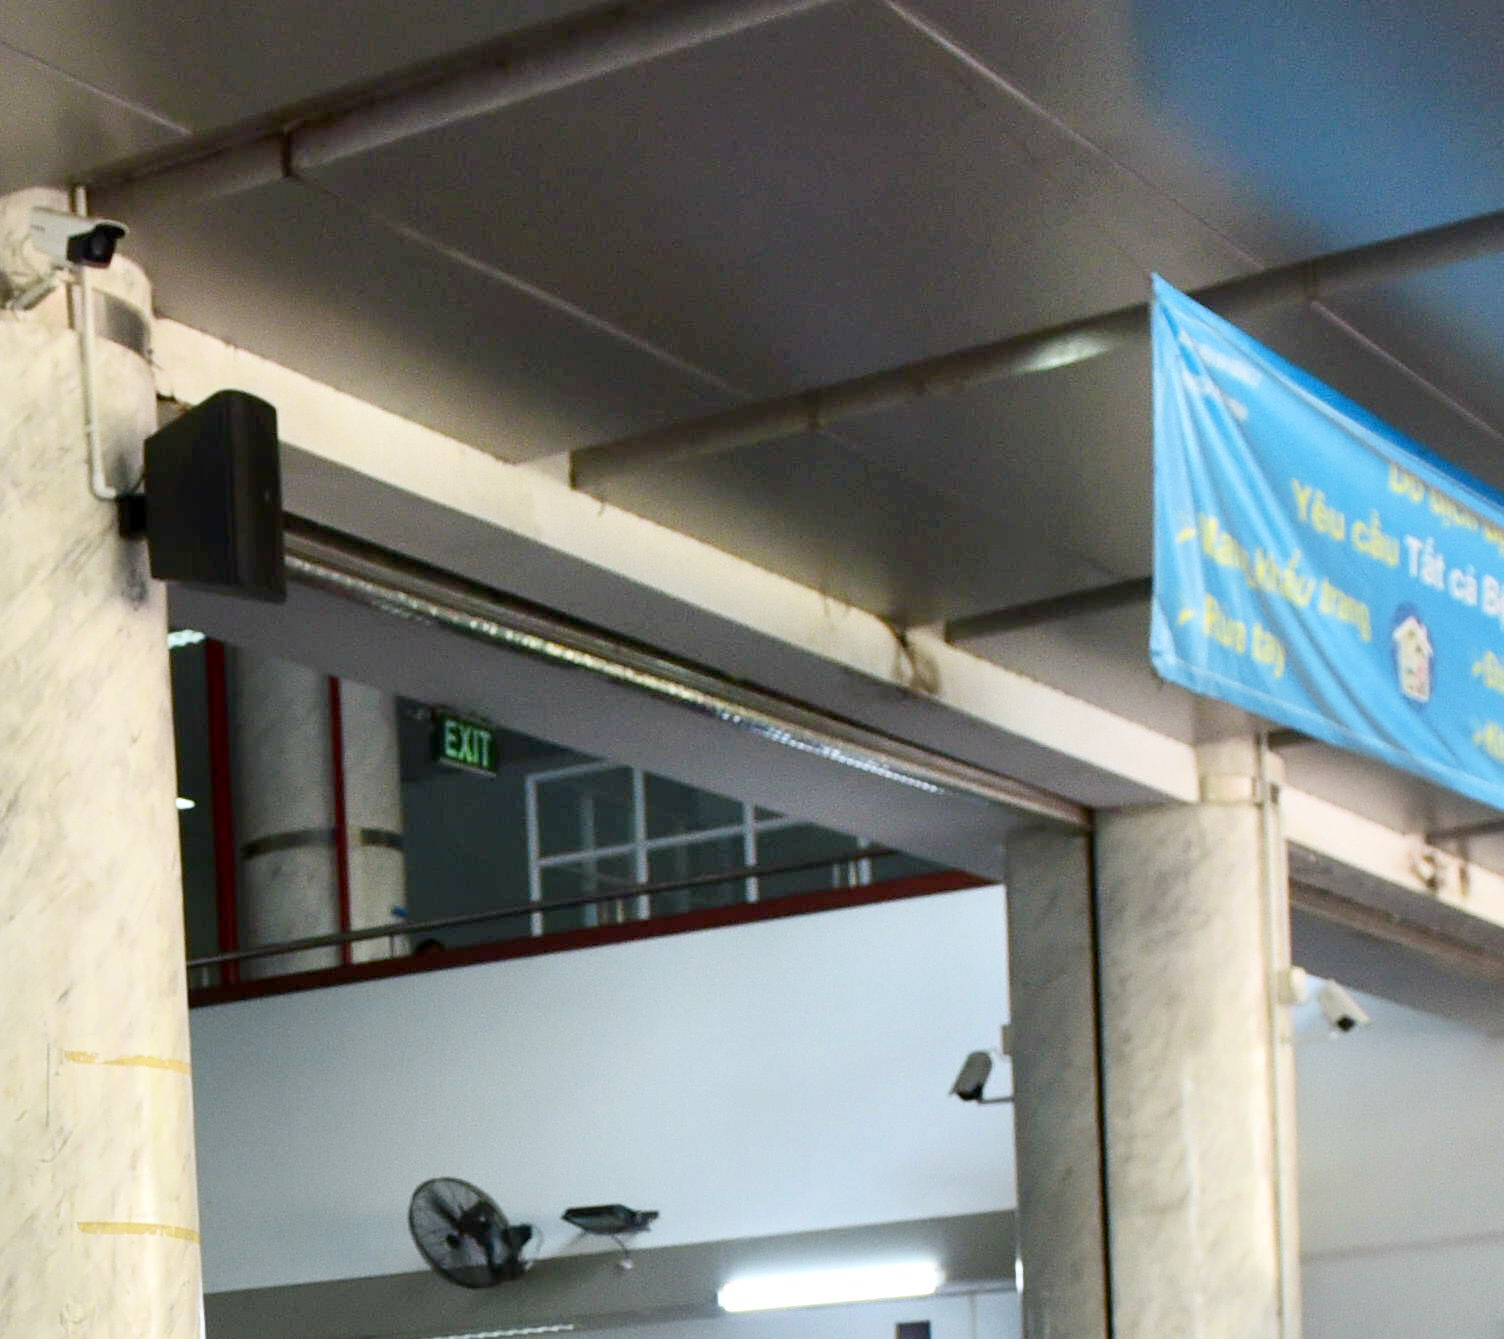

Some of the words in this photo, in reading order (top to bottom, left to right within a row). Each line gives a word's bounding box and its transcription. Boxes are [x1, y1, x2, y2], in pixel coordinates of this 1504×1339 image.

[1405, 534, 1445, 590] Tất
[1450, 563, 1477, 606] cả
[445, 719, 491, 768] EXIT
